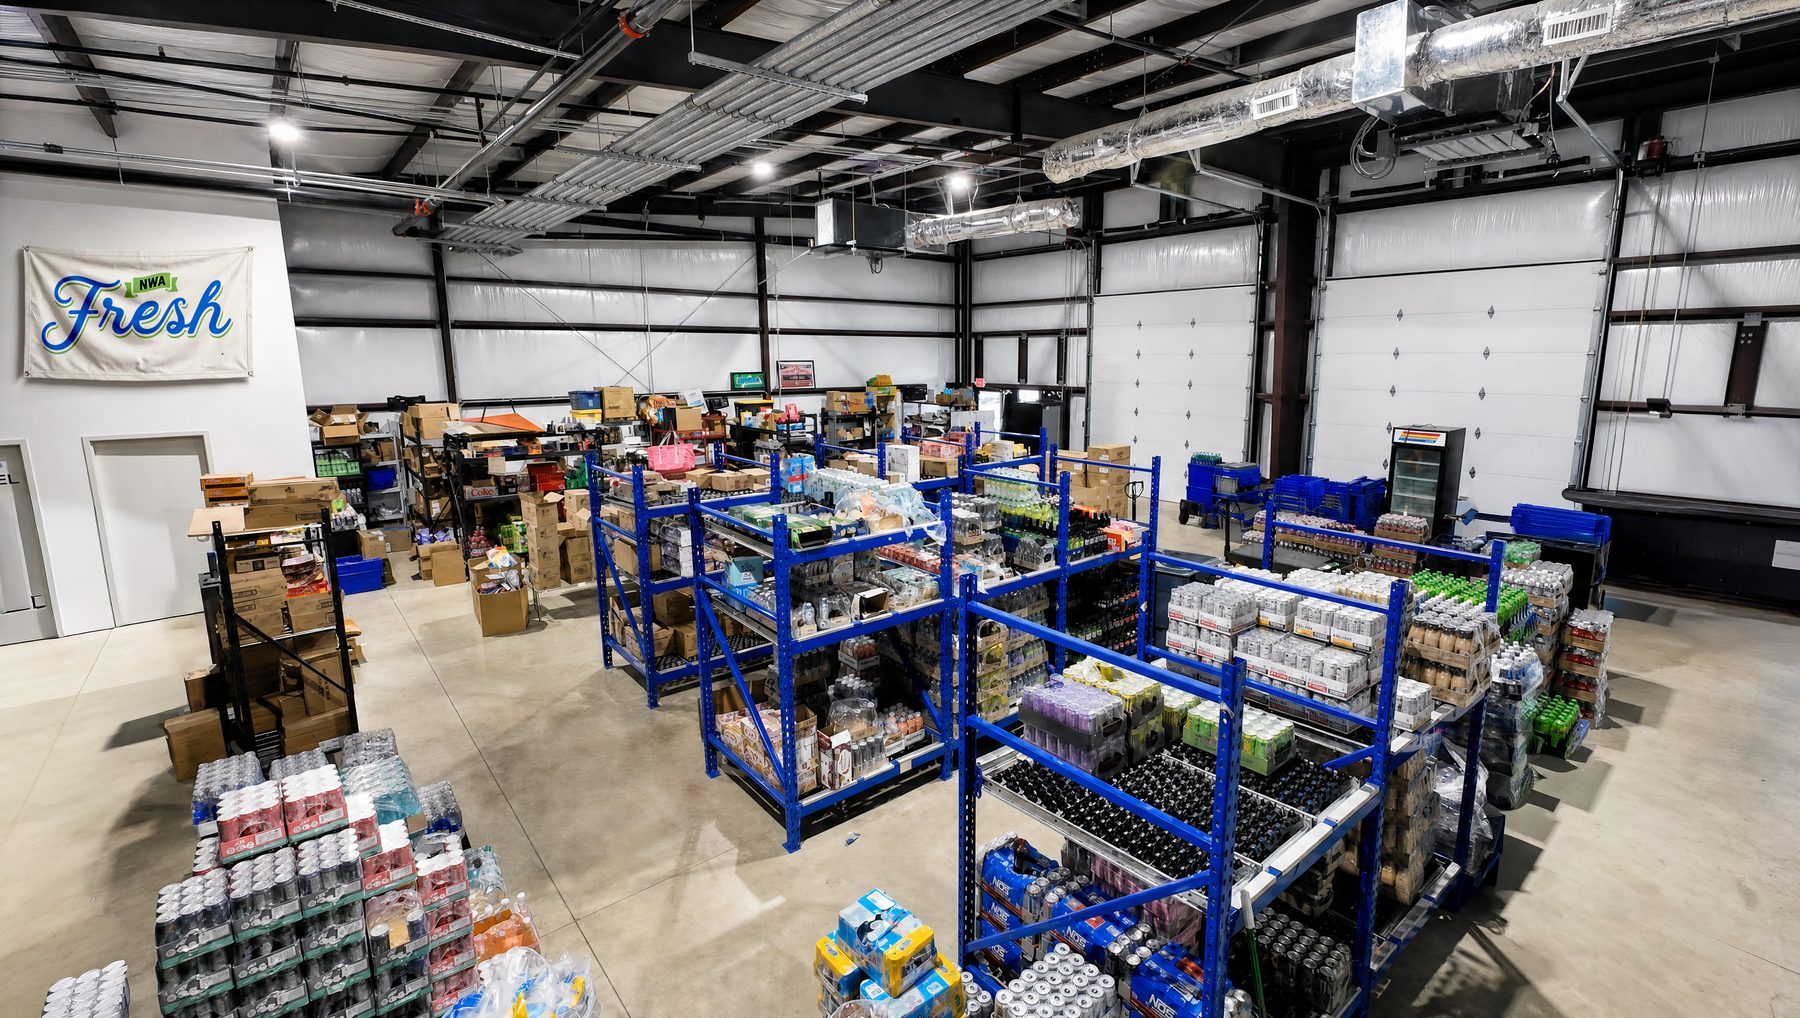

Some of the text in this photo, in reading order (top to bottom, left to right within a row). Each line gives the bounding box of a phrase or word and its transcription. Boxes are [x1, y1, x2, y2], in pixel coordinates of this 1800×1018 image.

[139, 276, 166, 291] NWA
[41, 275, 234, 355] Fresh
[471, 488, 494, 497] Coke
[992, 875, 1011, 896] NOS
[990, 902, 1010, 921] NOS
[1066, 925, 1087, 948] NOS
[990, 943, 1006, 958] OS
[1149, 993, 1177, 1018] NOS
